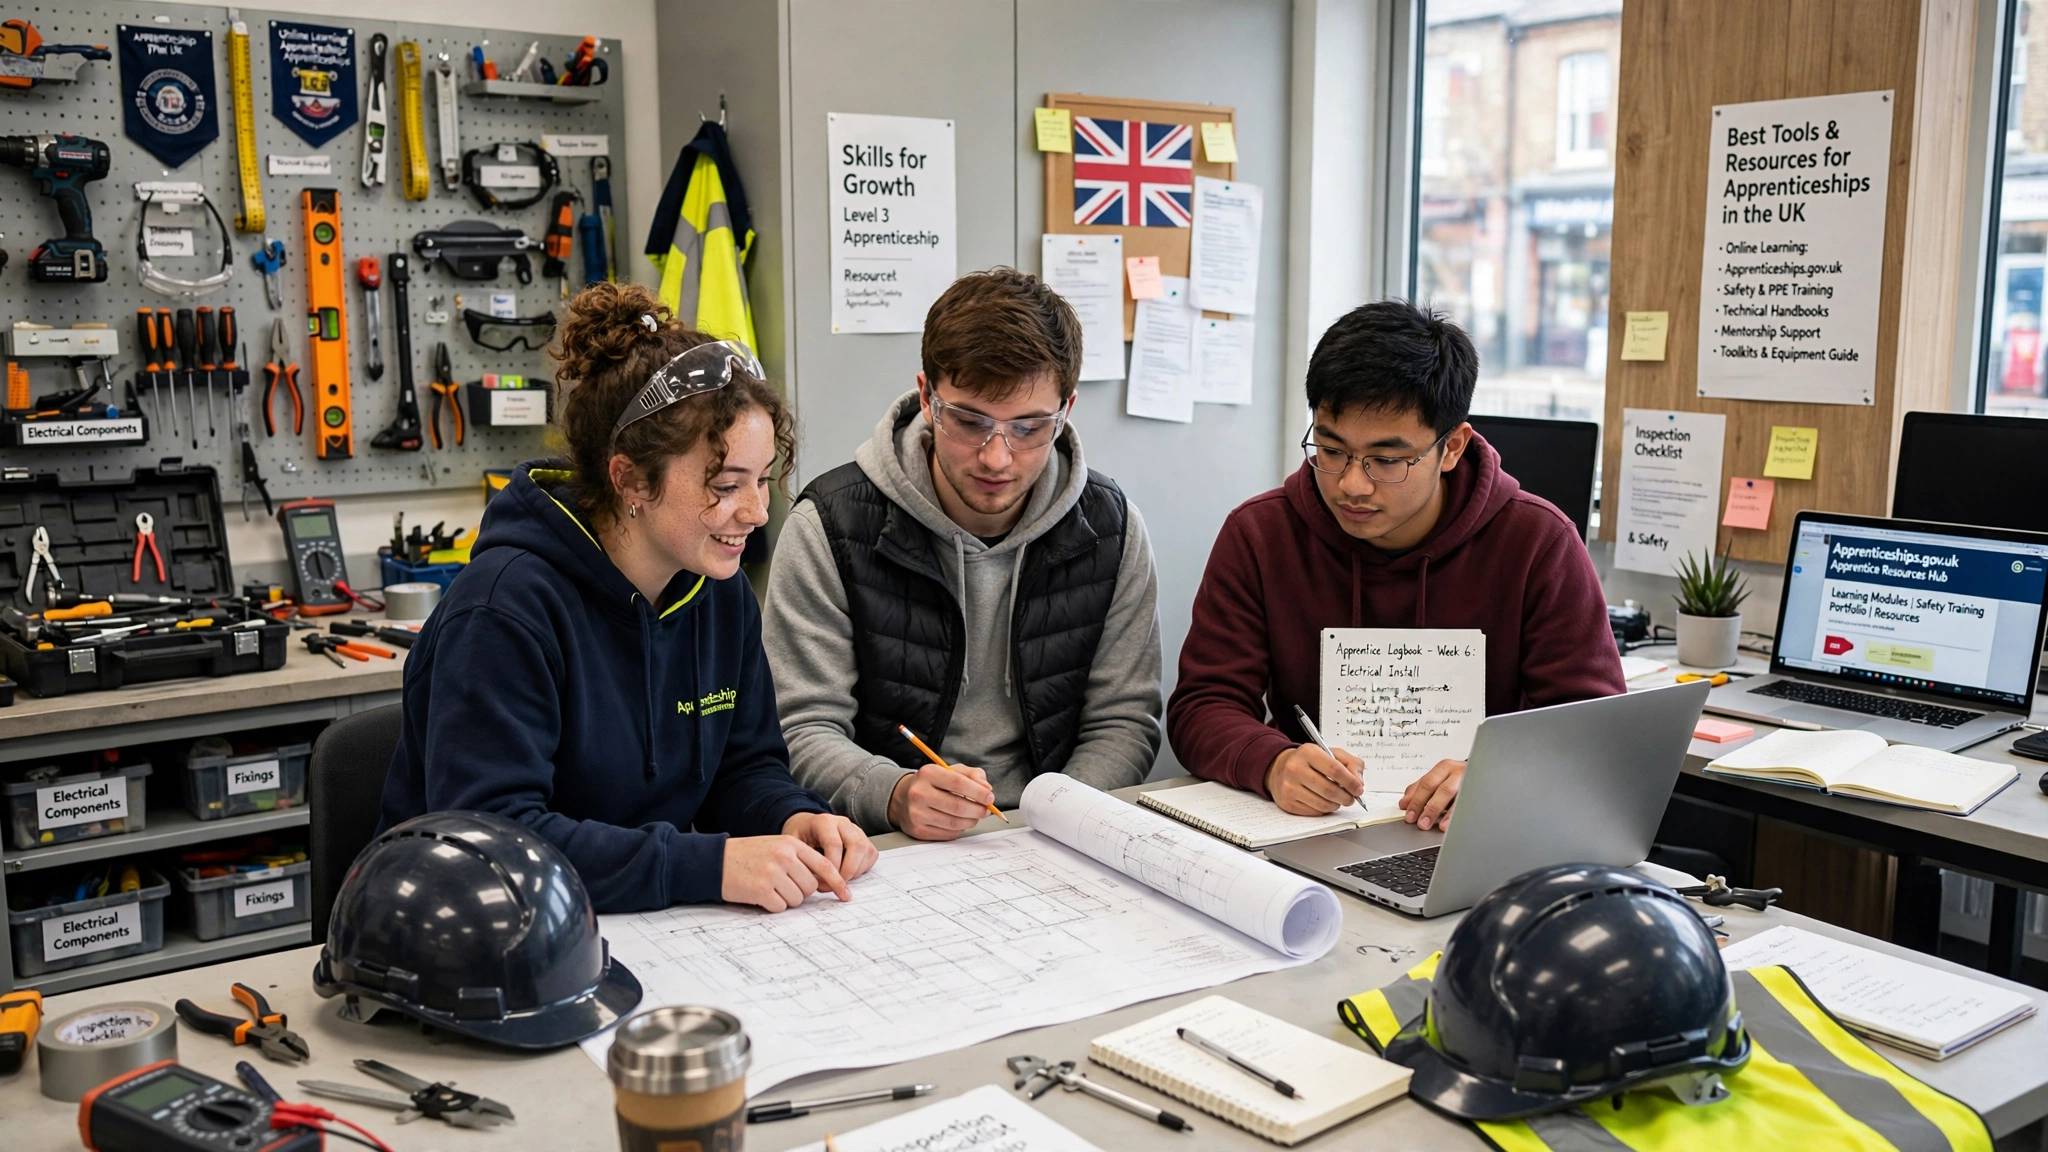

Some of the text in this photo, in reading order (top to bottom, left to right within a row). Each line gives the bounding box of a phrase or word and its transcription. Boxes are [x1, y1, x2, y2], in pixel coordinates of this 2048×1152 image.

[1727, 120, 1839, 147] Best Tools &
[843, 144, 927, 169] Skills for
[1726, 146, 1851, 172] Resources for
[843, 173, 915, 197] Growth
[1723, 172, 1870, 202] Apprenticeships
[844, 207, 889, 223] Level 3
[1722, 202, 1806, 224] in the UK
[843, 229, 939, 249] Apprenticeship
[1726, 240, 1808, 255] Online Learning:
[1725, 261, 1842, 278] Apprenticeships.gov.uk
[1723, 283, 1833, 299] Safety & PPE Training
[1723, 304, 1829, 317] Technical Handbooks
[1721, 324, 1821, 341] Mentorship Support
[1720, 345, 1859, 362] Toolkits & Equipment Guide
[28, 424, 137, 438] Electrical Components
[1635, 426, 1691, 443] Inspection
[1634, 443, 1683, 459] Checklist
[1628, 532, 1669, 551] & Safety
[1832, 542, 1959, 568] Apprenticeships.gov.uk
[1830, 559, 1948, 583] Apprentice Resources Hub
[1829, 601, 1867, 616] Portfolio
[1874, 608, 1920, 624] Resources
[1831, 587, 1869, 604] Learning
[1870, 592, 1908, 607] Modules
[1916, 598, 1946, 614] Safety
[1947, 601, 1985, 619] Training
[1336, 642, 1381, 660] Apprentice
[1387, 643, 1422, 660] Logbook
[1437, 645, 1459, 657] Week
[1340, 664, 1420, 677] Electrical Install
[235, 771, 274, 784] Fixings
[53, 784, 108, 803] Electrical
[45, 800, 121, 819] Components
[245, 890, 285, 906] Fixings
[63, 912, 118, 934] Electrical
[53, 926, 129, 950] Components
